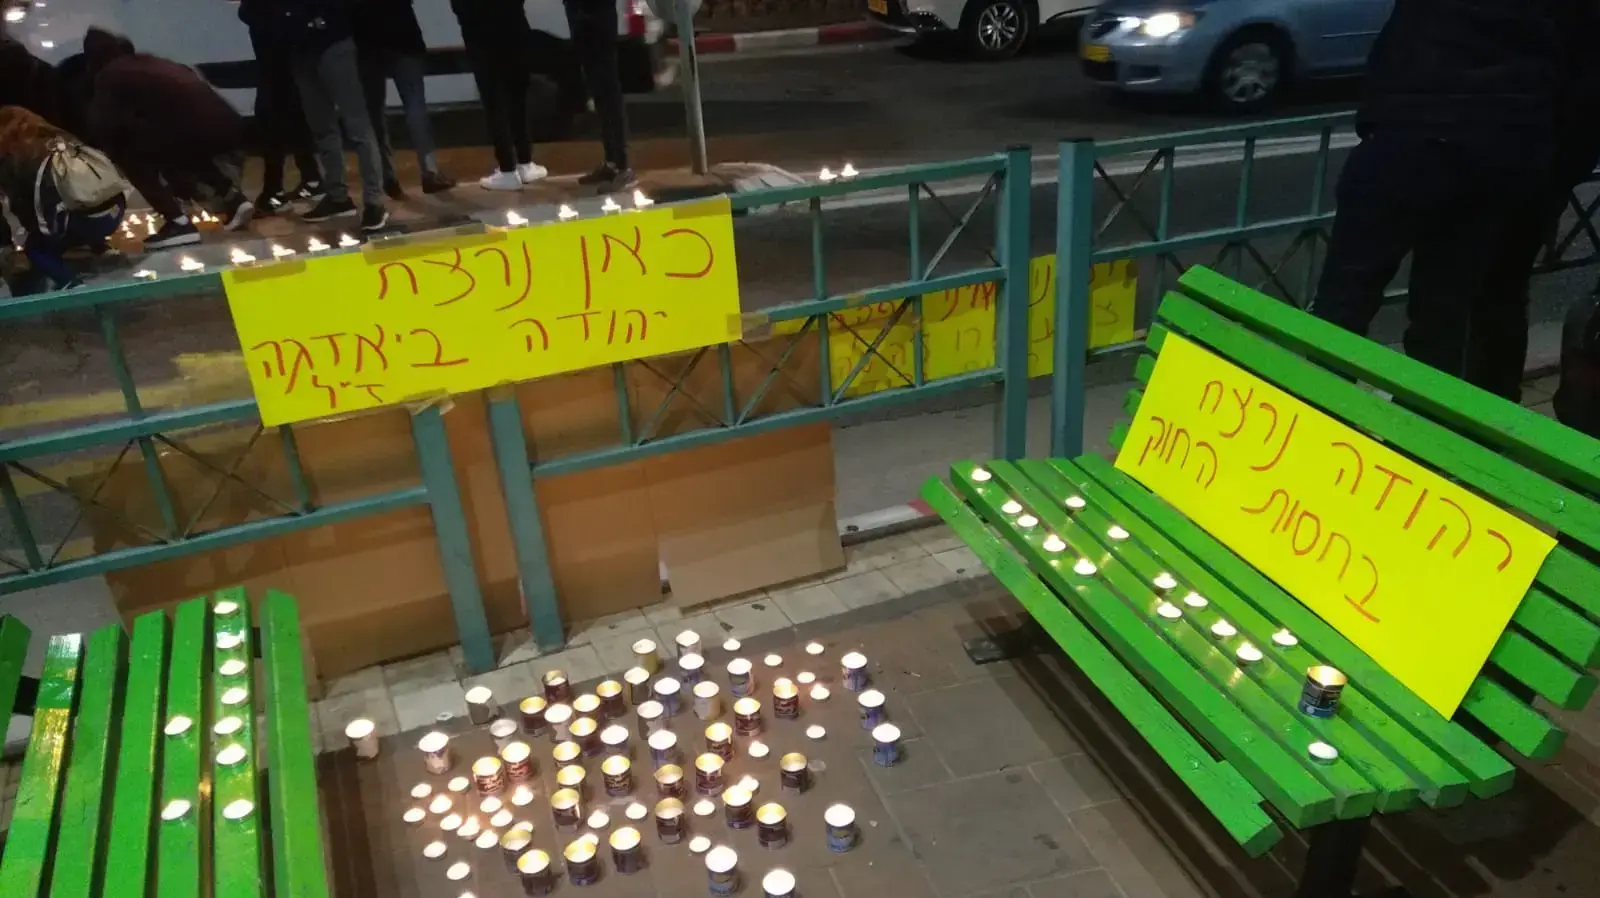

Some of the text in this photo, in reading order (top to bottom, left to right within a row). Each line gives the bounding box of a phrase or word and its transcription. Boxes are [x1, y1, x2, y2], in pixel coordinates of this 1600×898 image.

[379, 226, 714, 311] כאן נרצח
[250, 310, 668, 394] יהודה ביאדגה
[1199, 380, 1298, 472] נרצח
[1138, 416, 1380, 624] בחסות החוק
